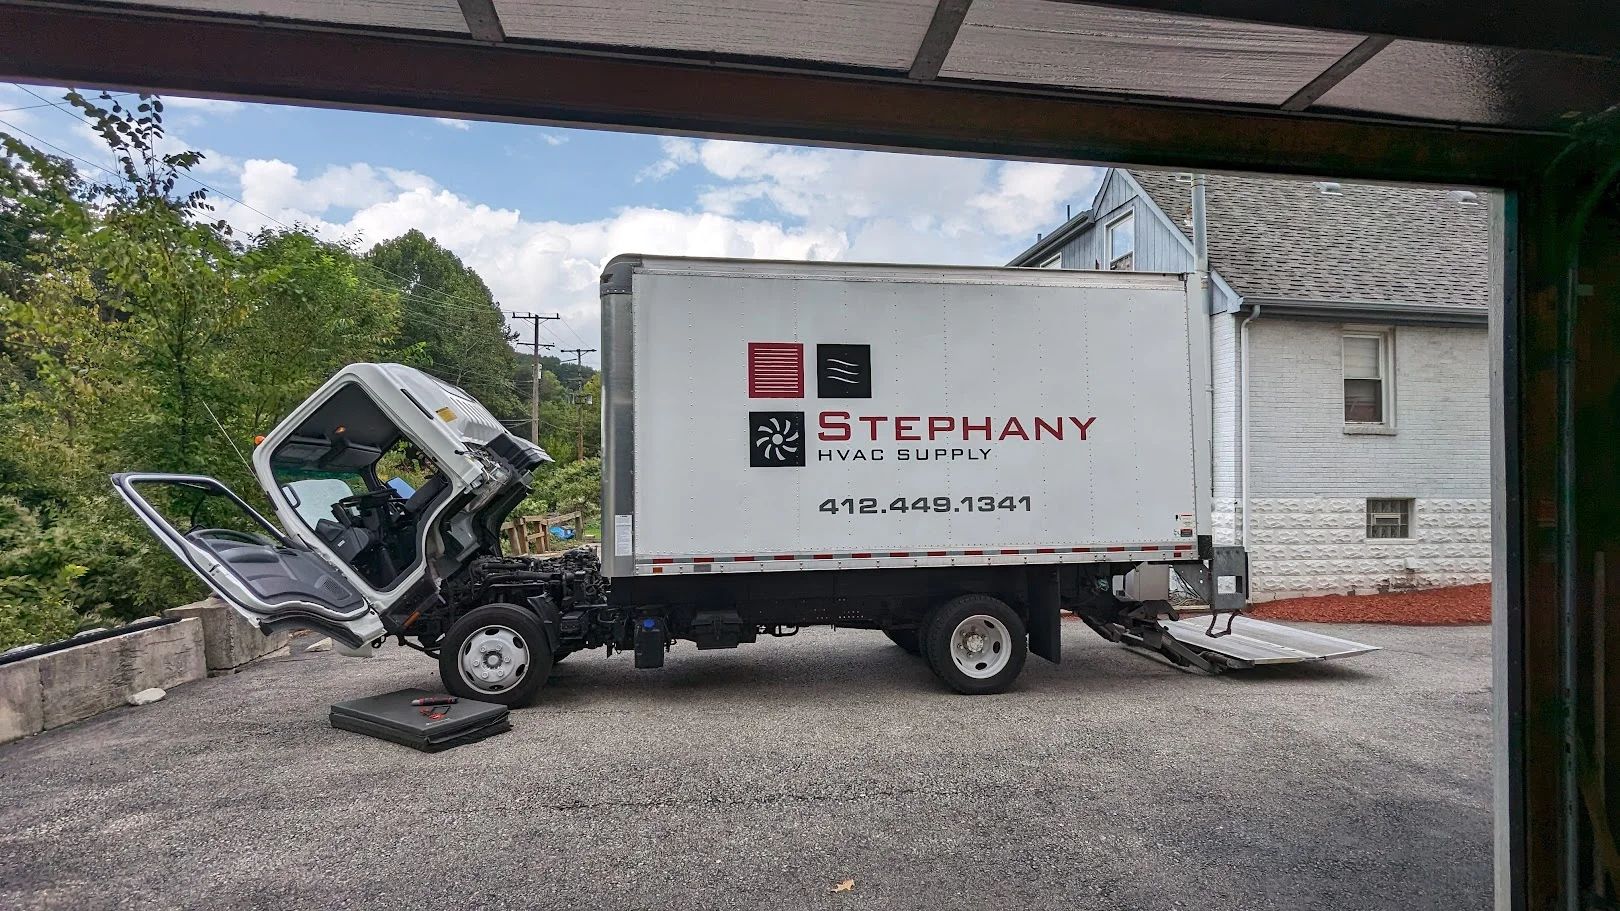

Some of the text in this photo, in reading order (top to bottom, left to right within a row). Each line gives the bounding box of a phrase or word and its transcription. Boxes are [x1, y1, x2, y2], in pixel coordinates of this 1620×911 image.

[818, 411, 1097, 442] STEPHANY
[818, 448, 992, 462] HVAC SUPPLY
[818, 495, 1032, 515] 412.449.1341
